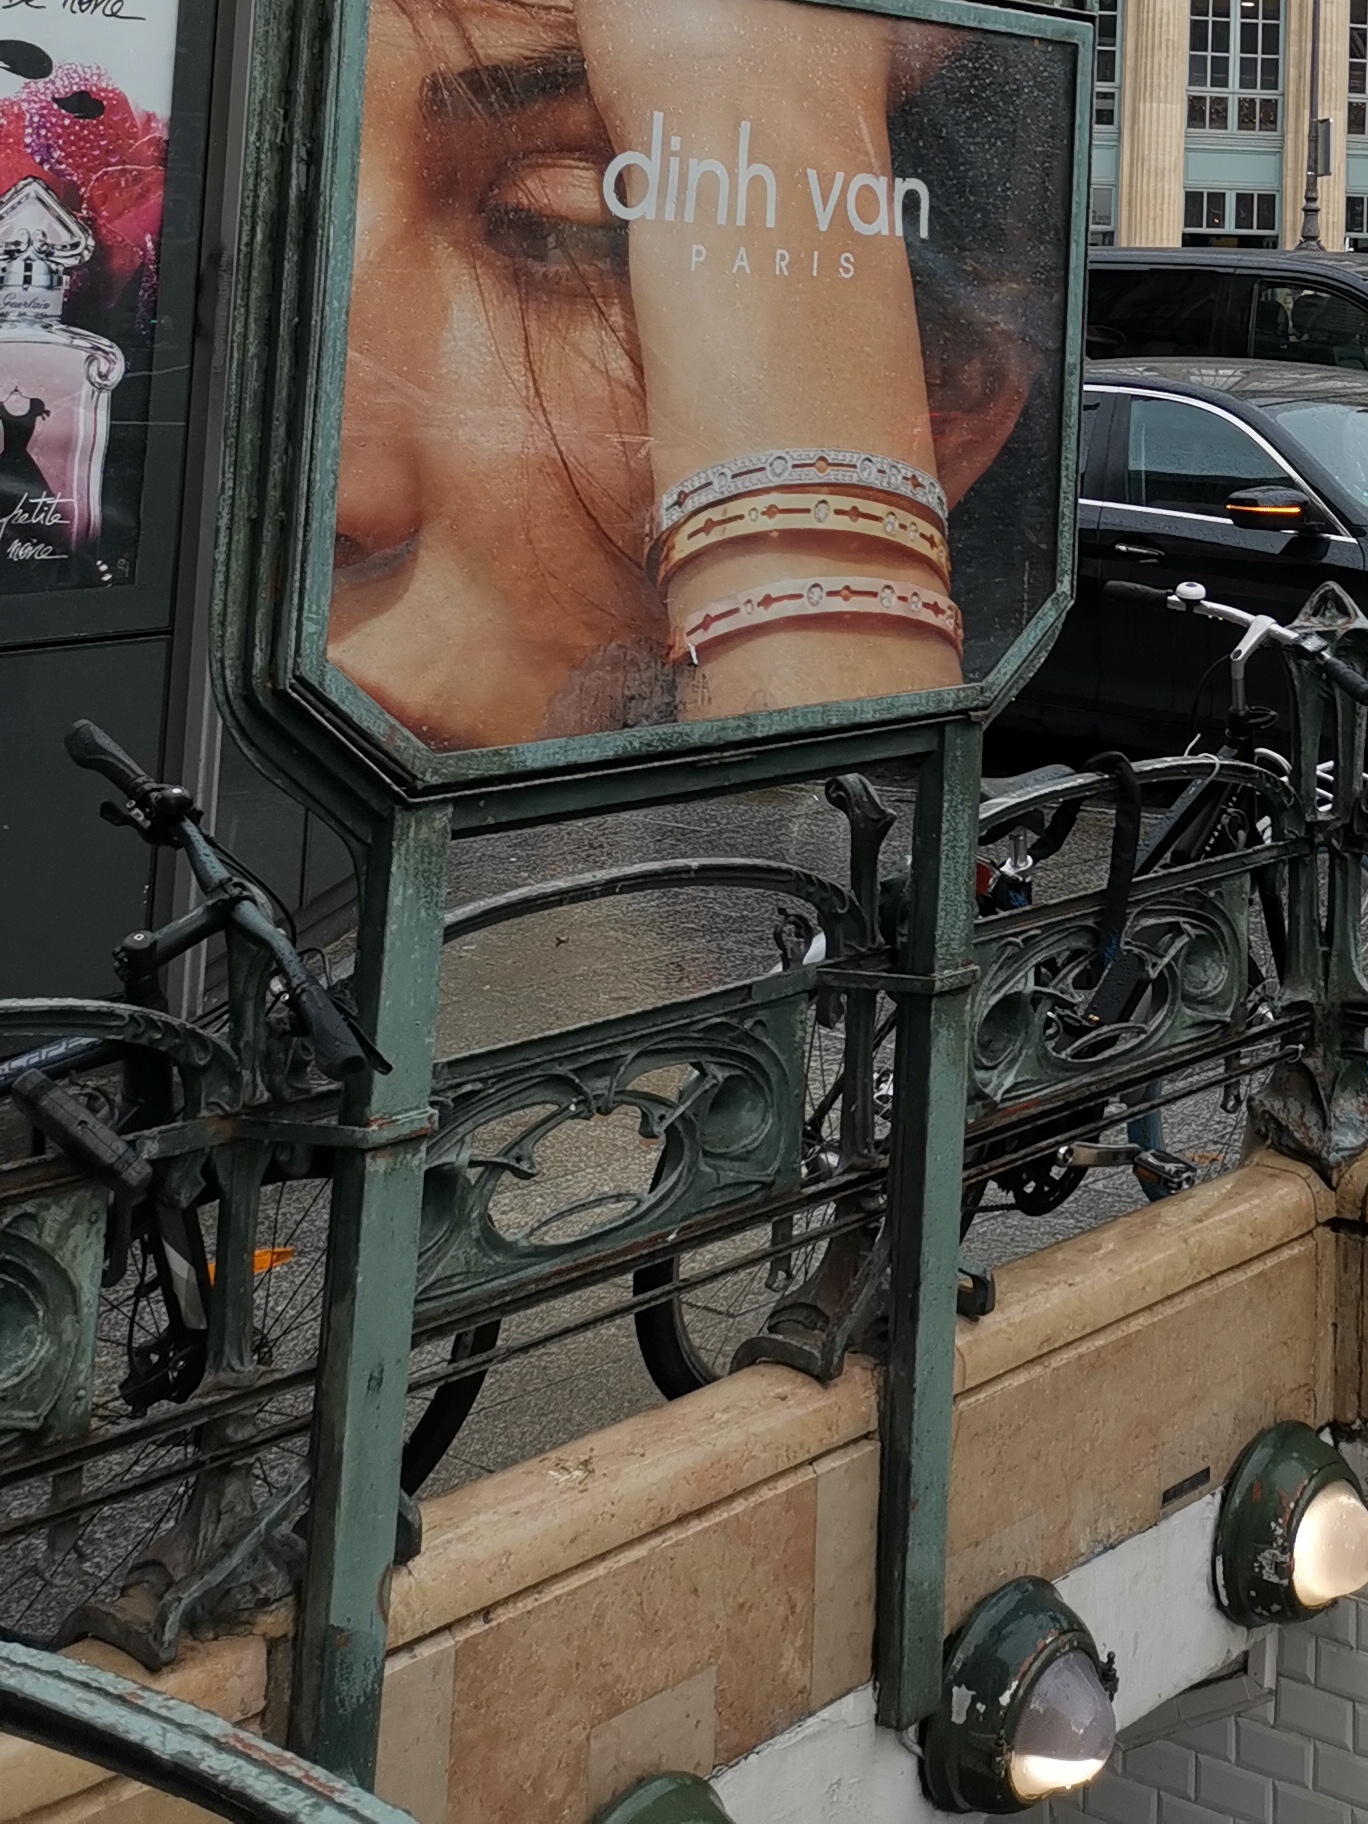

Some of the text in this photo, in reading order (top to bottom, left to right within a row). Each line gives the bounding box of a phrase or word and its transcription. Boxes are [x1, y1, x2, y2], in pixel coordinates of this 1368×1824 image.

[602, 110, 930, 241] dinh van
[690, 244, 855, 280] PARIS
